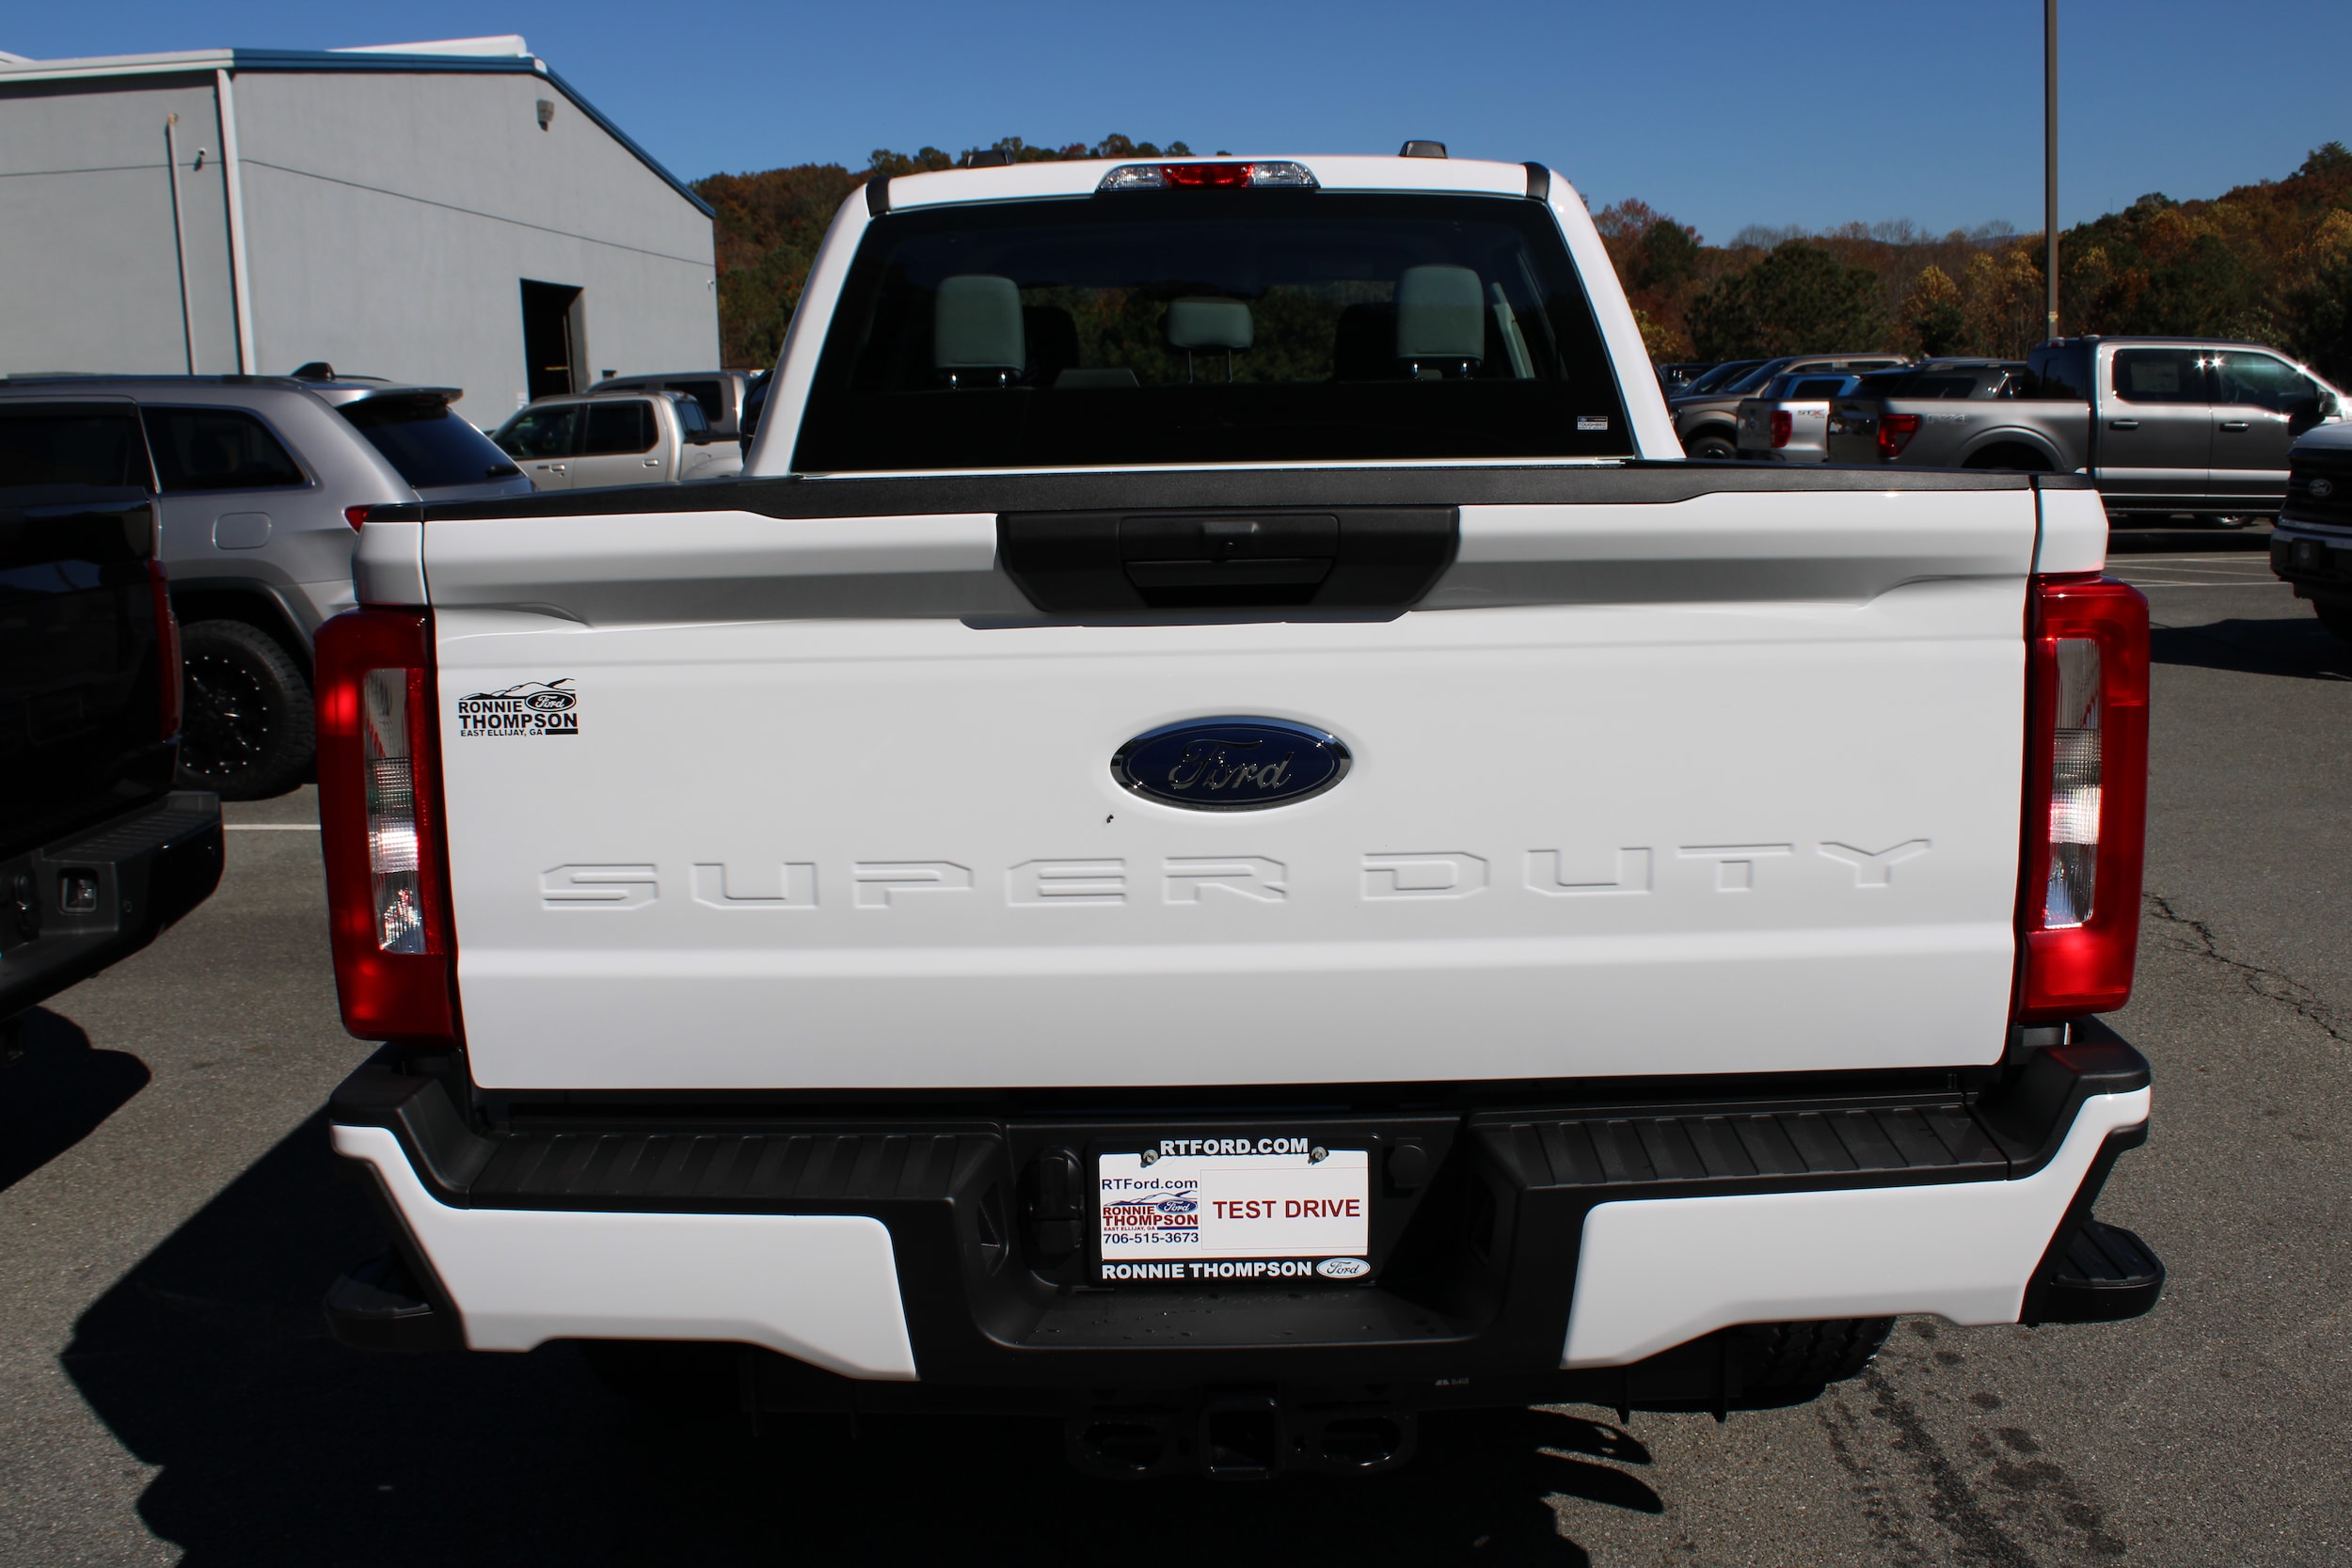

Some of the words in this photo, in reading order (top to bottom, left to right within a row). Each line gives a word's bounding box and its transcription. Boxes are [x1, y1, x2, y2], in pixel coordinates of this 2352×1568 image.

[458, 701, 523, 713] RONNIE
[534, 694, 565, 708] Ford
[458, 713, 578, 729] THOMPSON
[529, 728, 543, 736] GA
[539, 855, 1289, 912] SUPER
[1360, 837, 1932, 902] DUTY
[1159, 1138, 1309, 1155] RTFORD.COM
[1101, 1178, 1199, 1191] RTFord.com
[1103, 1207, 1154, 1215] RONNIE
[1164, 1200, 1191, 1212] Ford
[1212, 1200, 1278, 1220] TEST
[1284, 1198, 1361, 1219] DRIVE
[1103, 1214, 1199, 1227] THOMPSON
[1103, 1233, 1200, 1244] 706-515-3673
[1102, 1263, 1185, 1280] RONNIE
[1189, 1261, 1313, 1279] THOMPSON
[1326, 1259, 1360, 1276] Ford
